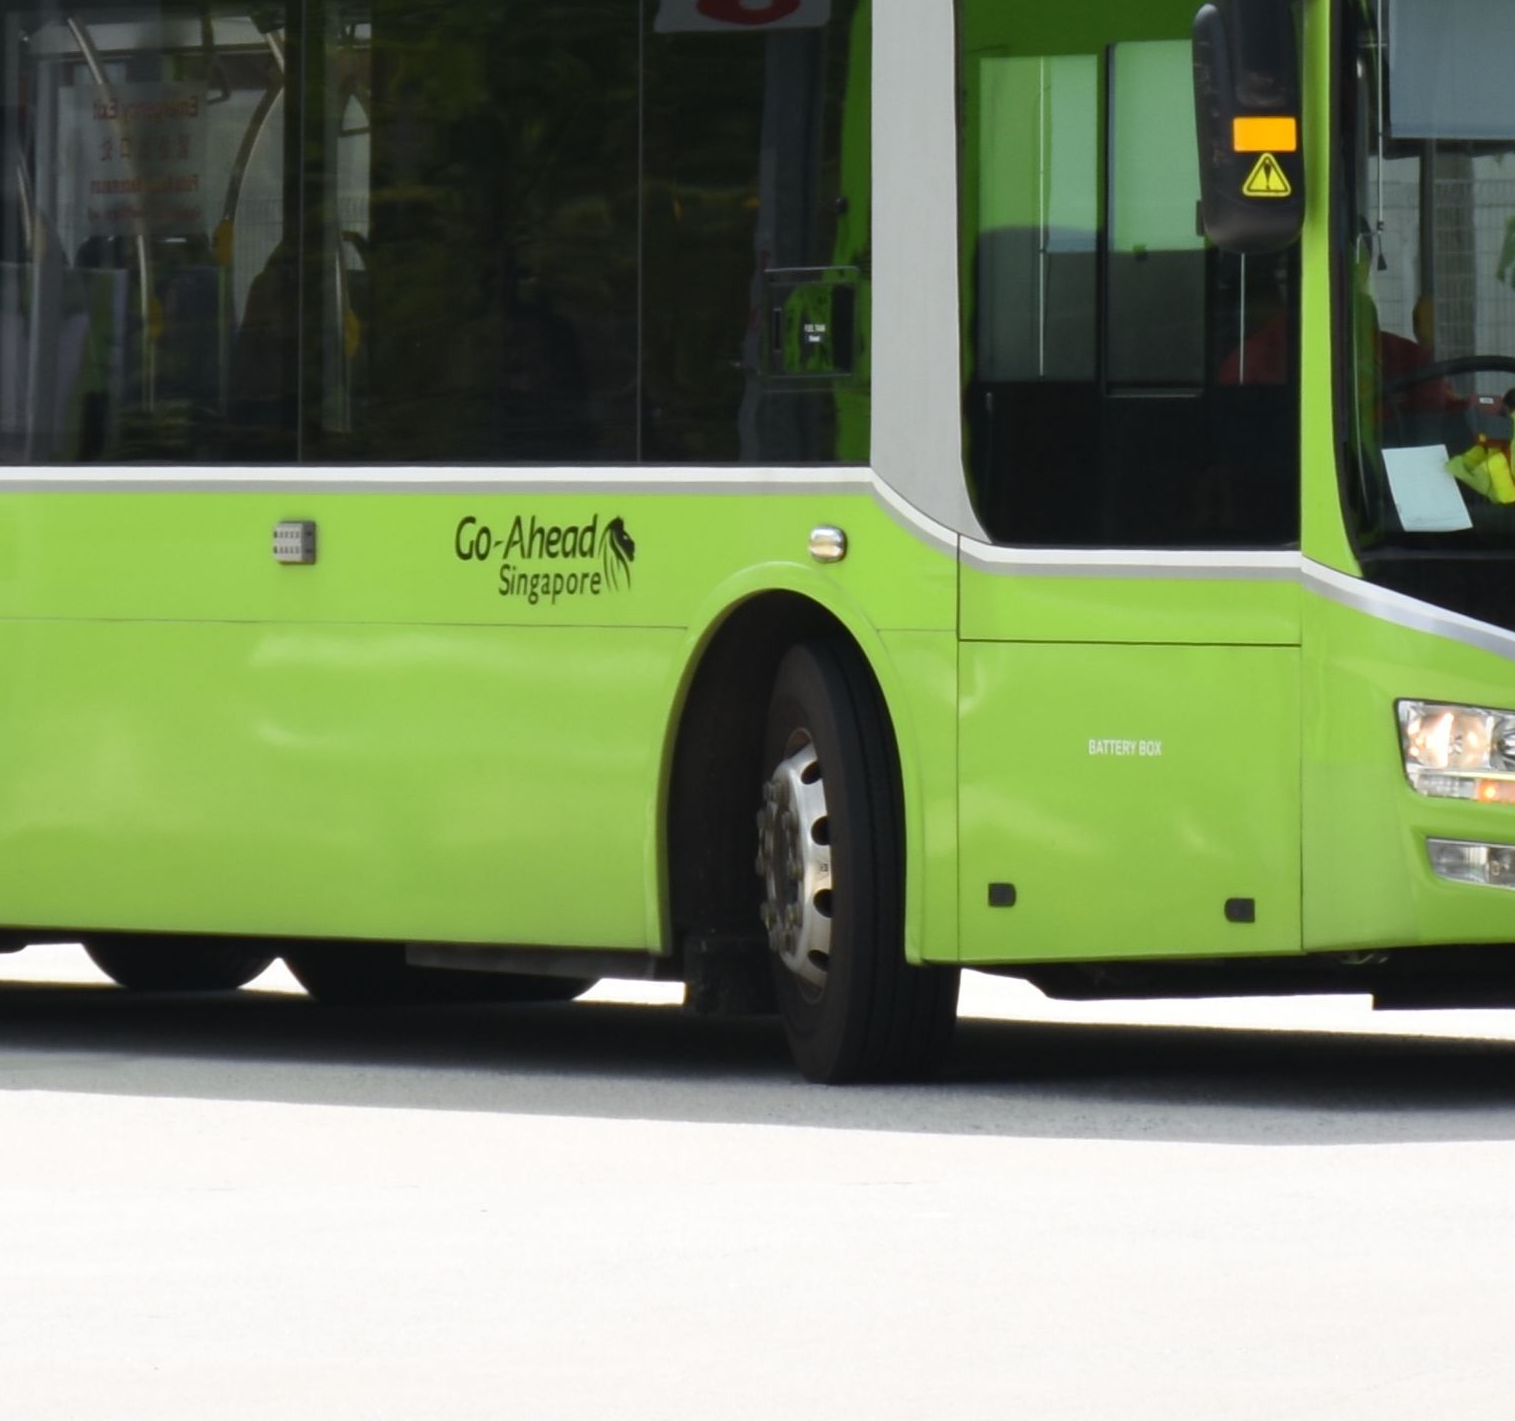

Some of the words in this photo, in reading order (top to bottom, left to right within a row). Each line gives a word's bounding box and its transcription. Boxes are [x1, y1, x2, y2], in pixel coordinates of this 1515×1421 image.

[455, 513, 598, 561] Go-Ahead
[498, 563, 602, 605] Singapore
[1088, 738, 1137, 756] BATTERY
[1138, 740, 1163, 757] BOX
